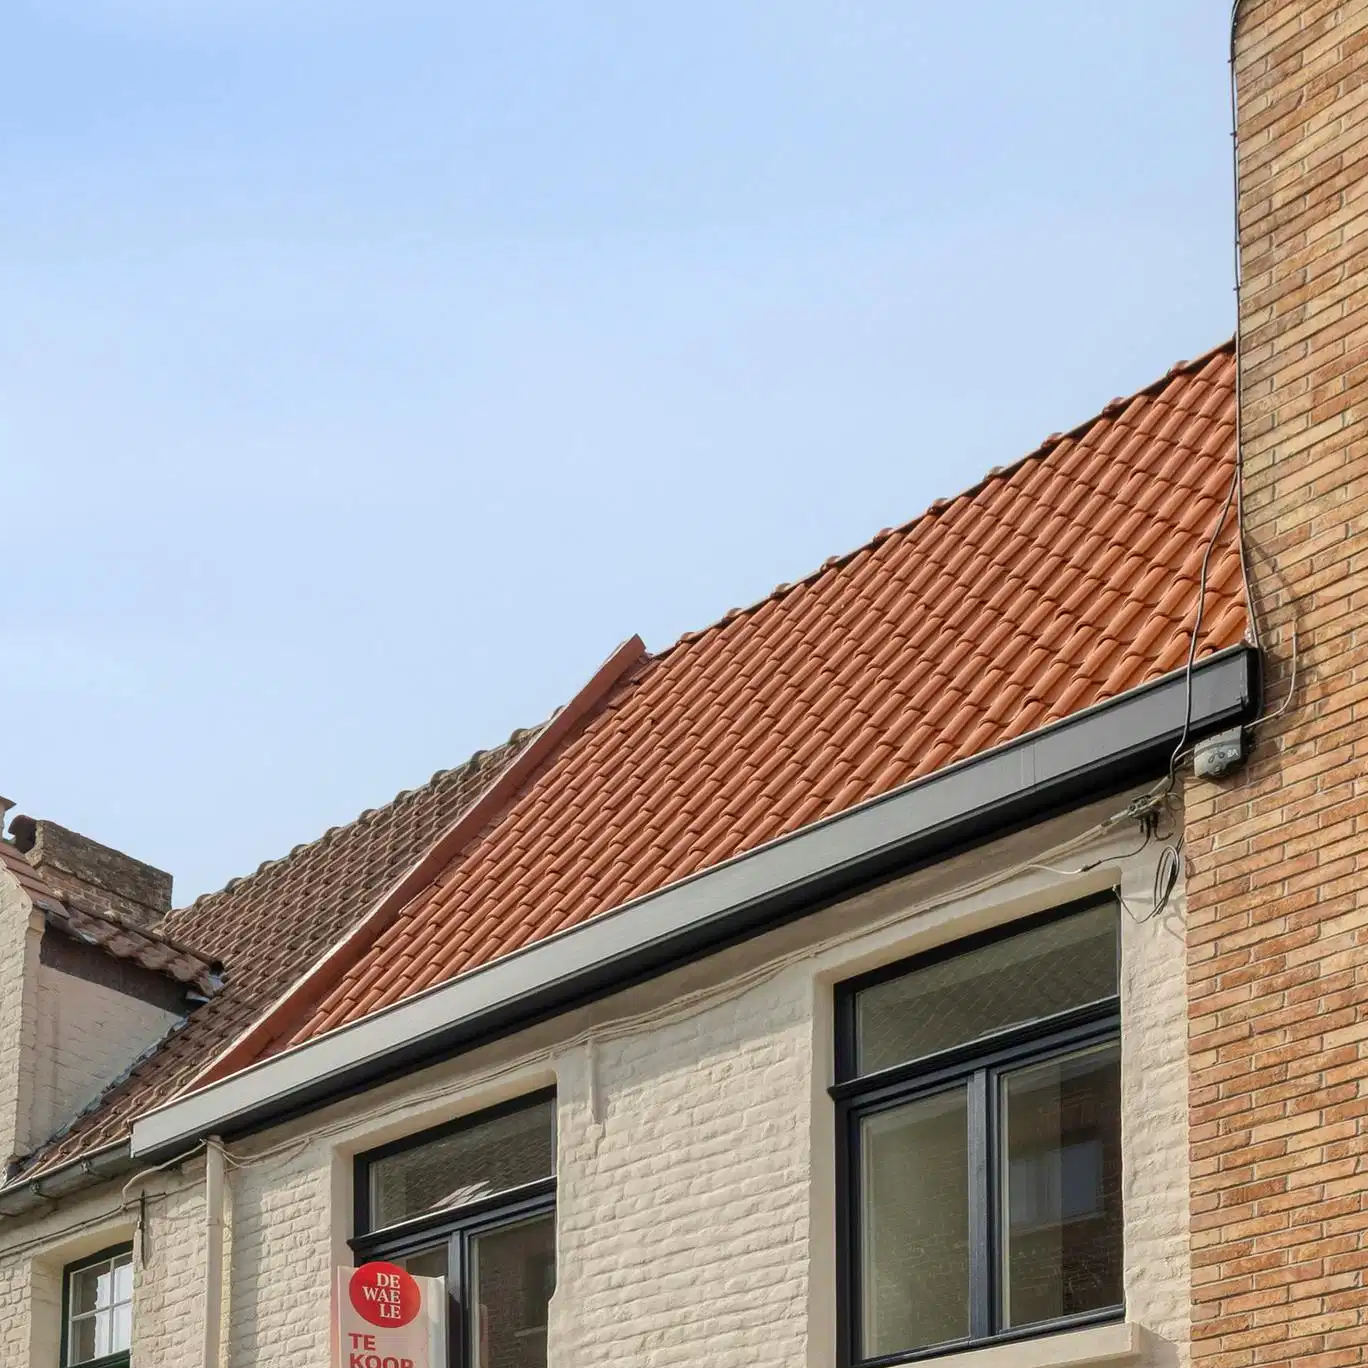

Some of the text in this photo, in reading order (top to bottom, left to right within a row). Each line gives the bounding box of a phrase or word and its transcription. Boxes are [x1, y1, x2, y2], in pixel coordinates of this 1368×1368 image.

[376, 1272, 400, 1289] DE
[362, 1285, 401, 1304] WAE
[379, 1303, 401, 1319] LE
[348, 1332, 376, 1351] TE
